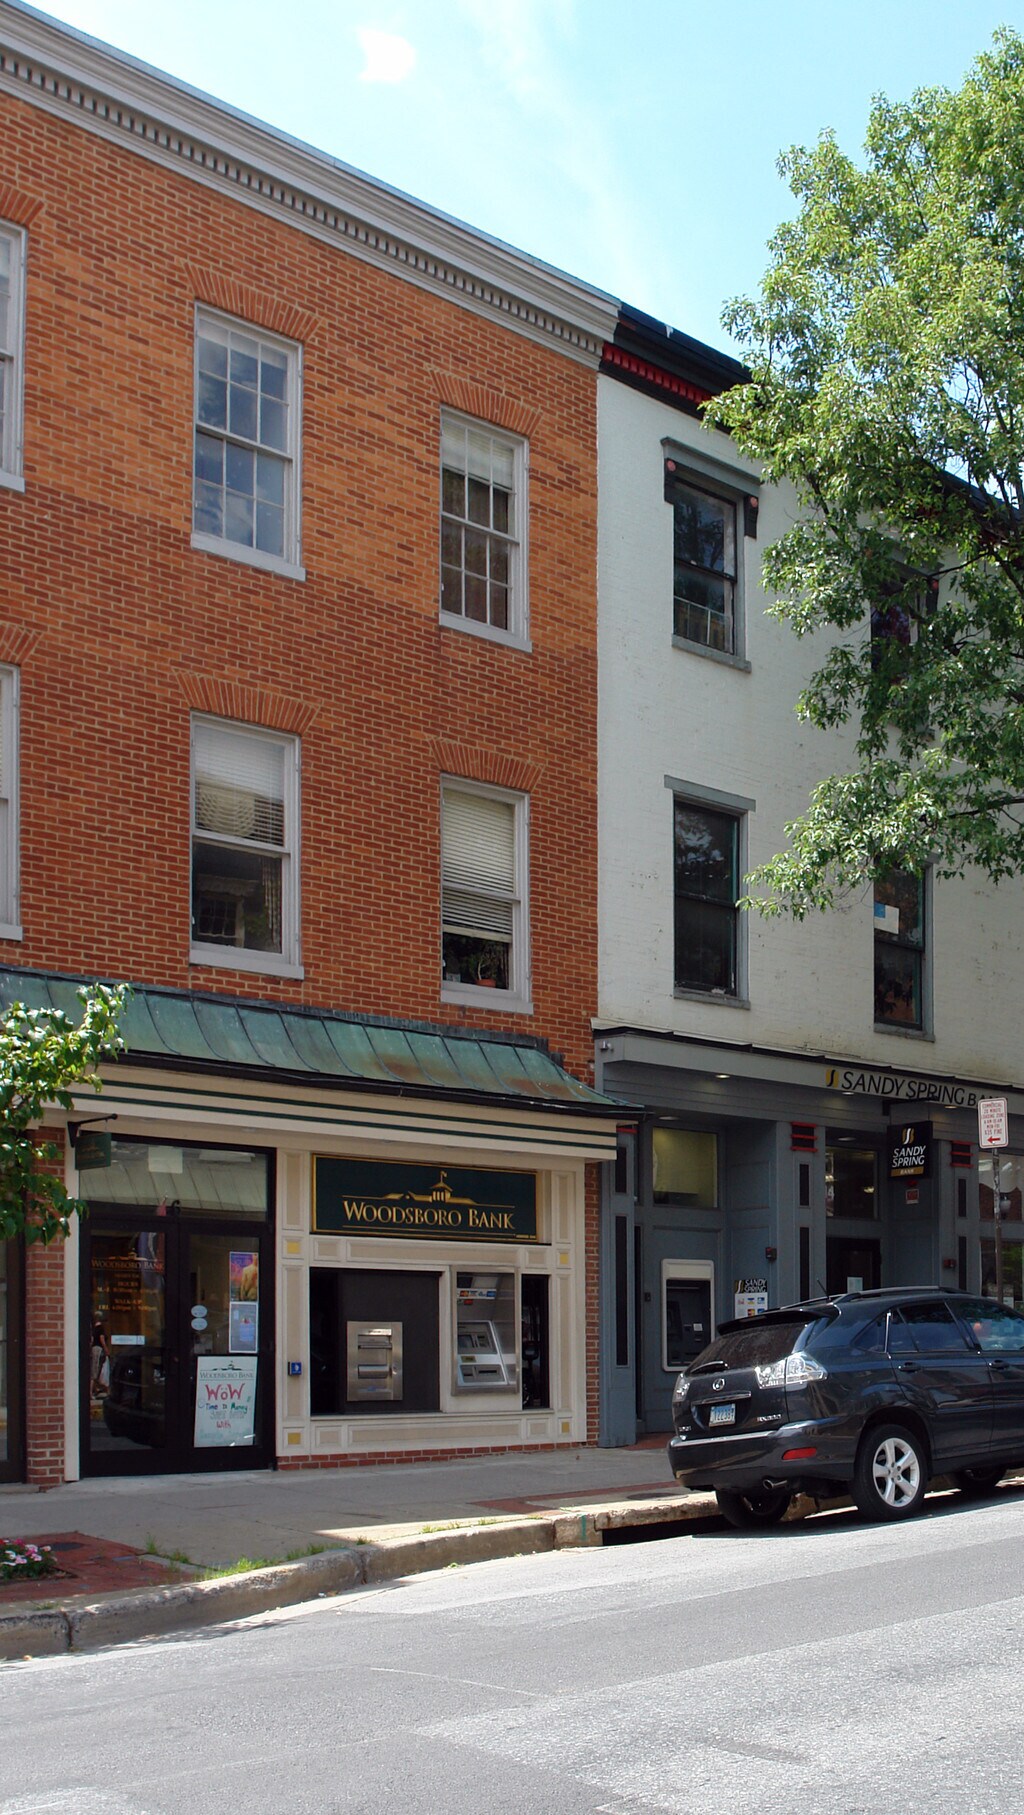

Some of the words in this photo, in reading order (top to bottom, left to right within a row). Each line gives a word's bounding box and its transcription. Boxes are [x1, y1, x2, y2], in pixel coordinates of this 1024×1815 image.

[842, 1071, 906, 1096] SANDY
[906, 1080, 965, 1106] SPRING
[893, 1145, 926, 1158] SANDY
[892, 1155, 925, 1168] SPRING
[343, 1200, 462, 1226] WOODSBORO
[468, 1208, 516, 1230] BANK
[91, 1259, 142, 1268] WOODSBORO
[143, 1261, 164, 1270] BANK
